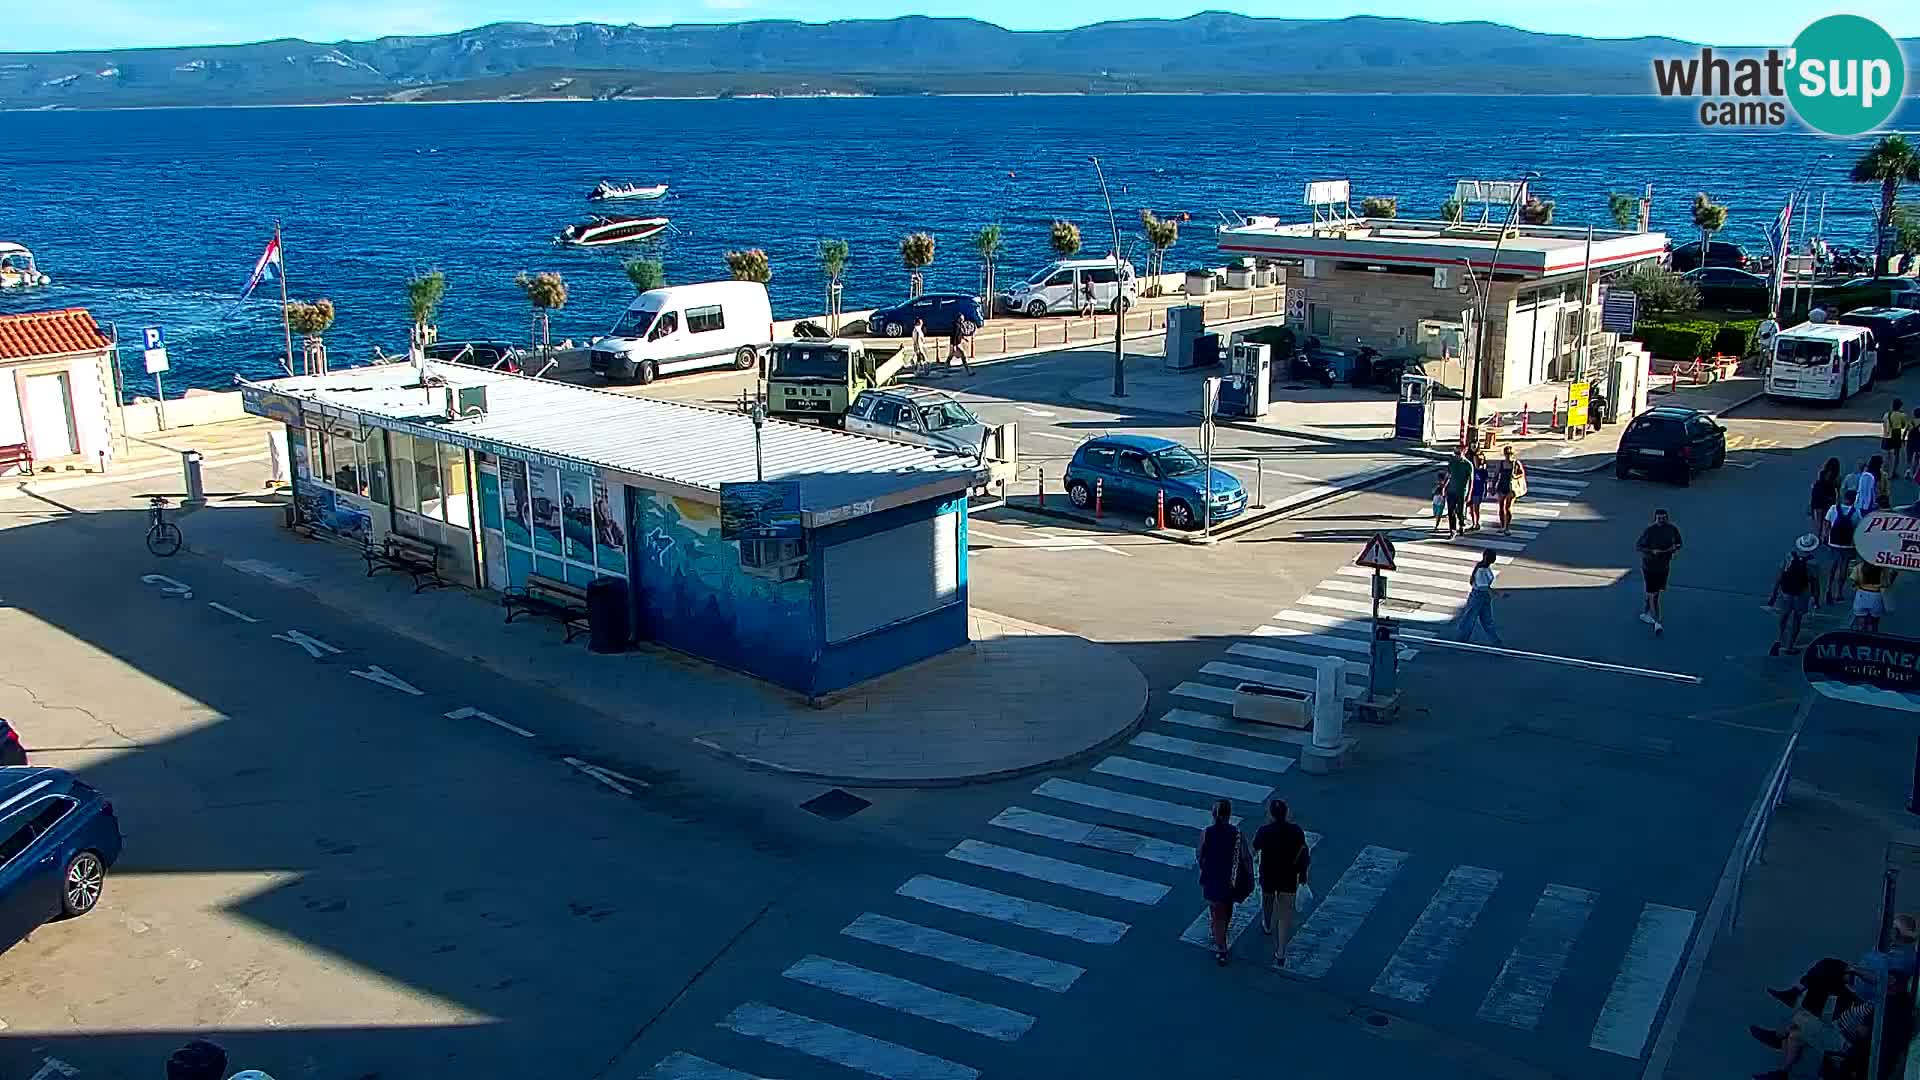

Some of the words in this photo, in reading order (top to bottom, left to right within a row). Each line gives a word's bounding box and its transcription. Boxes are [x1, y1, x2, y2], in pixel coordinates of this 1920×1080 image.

[146, 328, 160, 348] P
[784, 387, 832, 397] BILI
[493, 445, 507, 456] BUS
[508, 448, 541, 465] STATION
[543, 456, 569, 471] TICKET
[570, 461, 596, 476] OFFICE
[1887, 667, 1914, 681] bar
